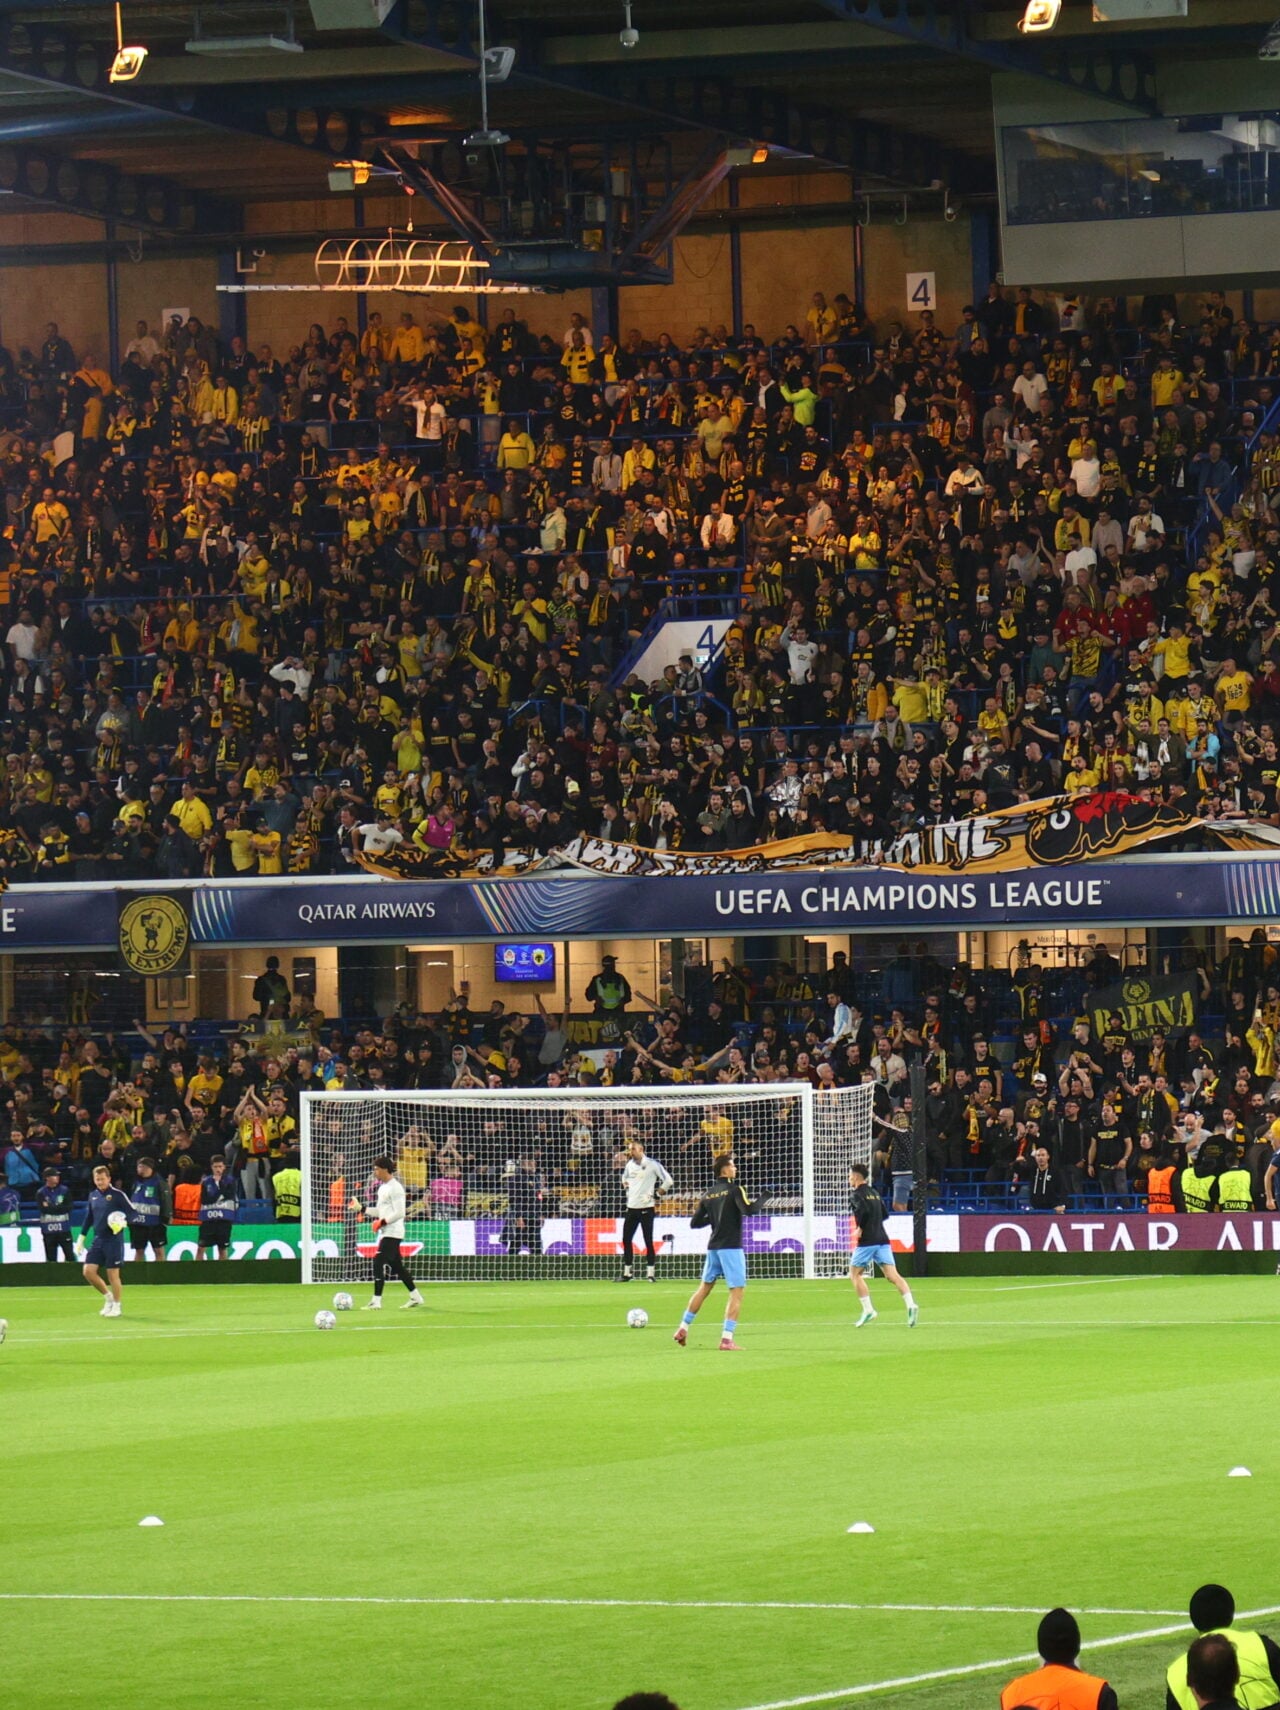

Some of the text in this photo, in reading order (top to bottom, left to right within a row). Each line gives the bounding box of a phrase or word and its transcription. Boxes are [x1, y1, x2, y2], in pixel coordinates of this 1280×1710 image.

[912, 278, 931, 306] 4
[696, 624, 717, 655] 4
[298, 902, 436, 923] QATAR AIRWAYS
[715, 888, 793, 915] UEFA
[800, 883, 977, 913] CHAMPIONS
[119, 925, 187, 968] AEK EXTREME
[47, 1222, 63, 1232] 001
[207, 1210, 224, 1219] 004
[984, 1221, 1180, 1252] QATAR
